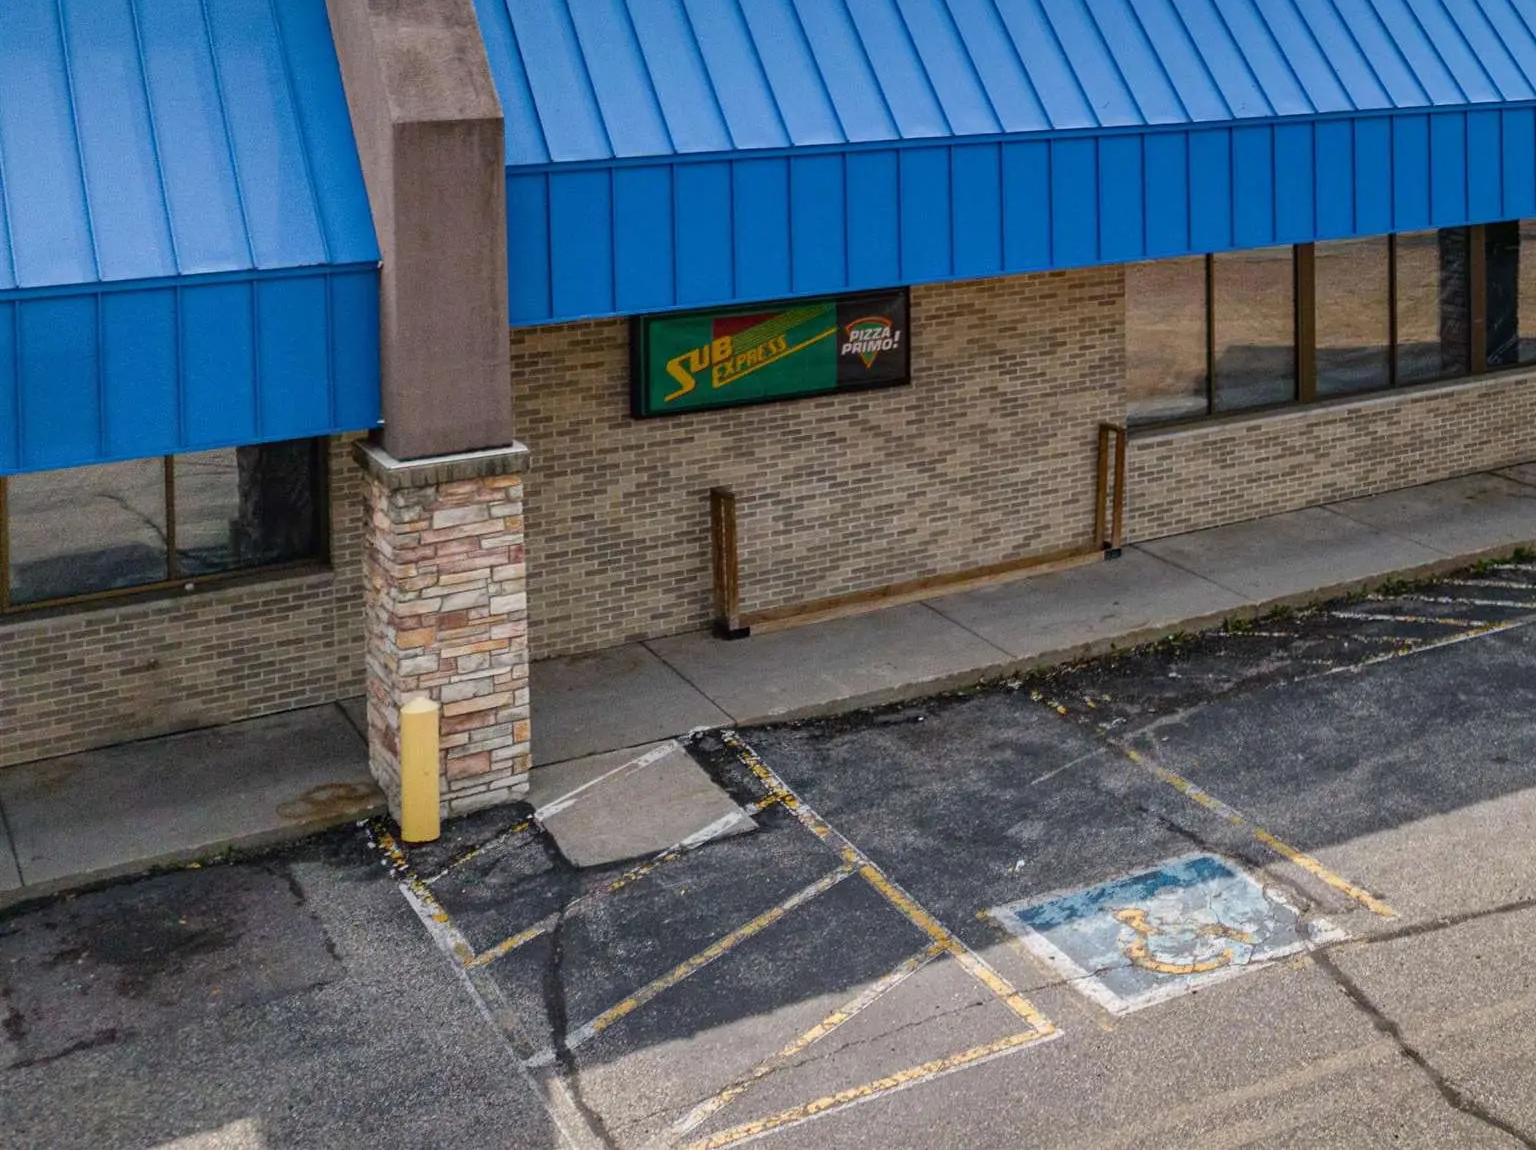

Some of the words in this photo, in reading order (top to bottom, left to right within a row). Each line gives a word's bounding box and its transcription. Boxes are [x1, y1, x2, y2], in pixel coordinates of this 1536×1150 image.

[841, 330, 900, 355] PRIMO!
[849, 326, 890, 342] PIZZA
[712, 334, 788, 388] EXPRESS
